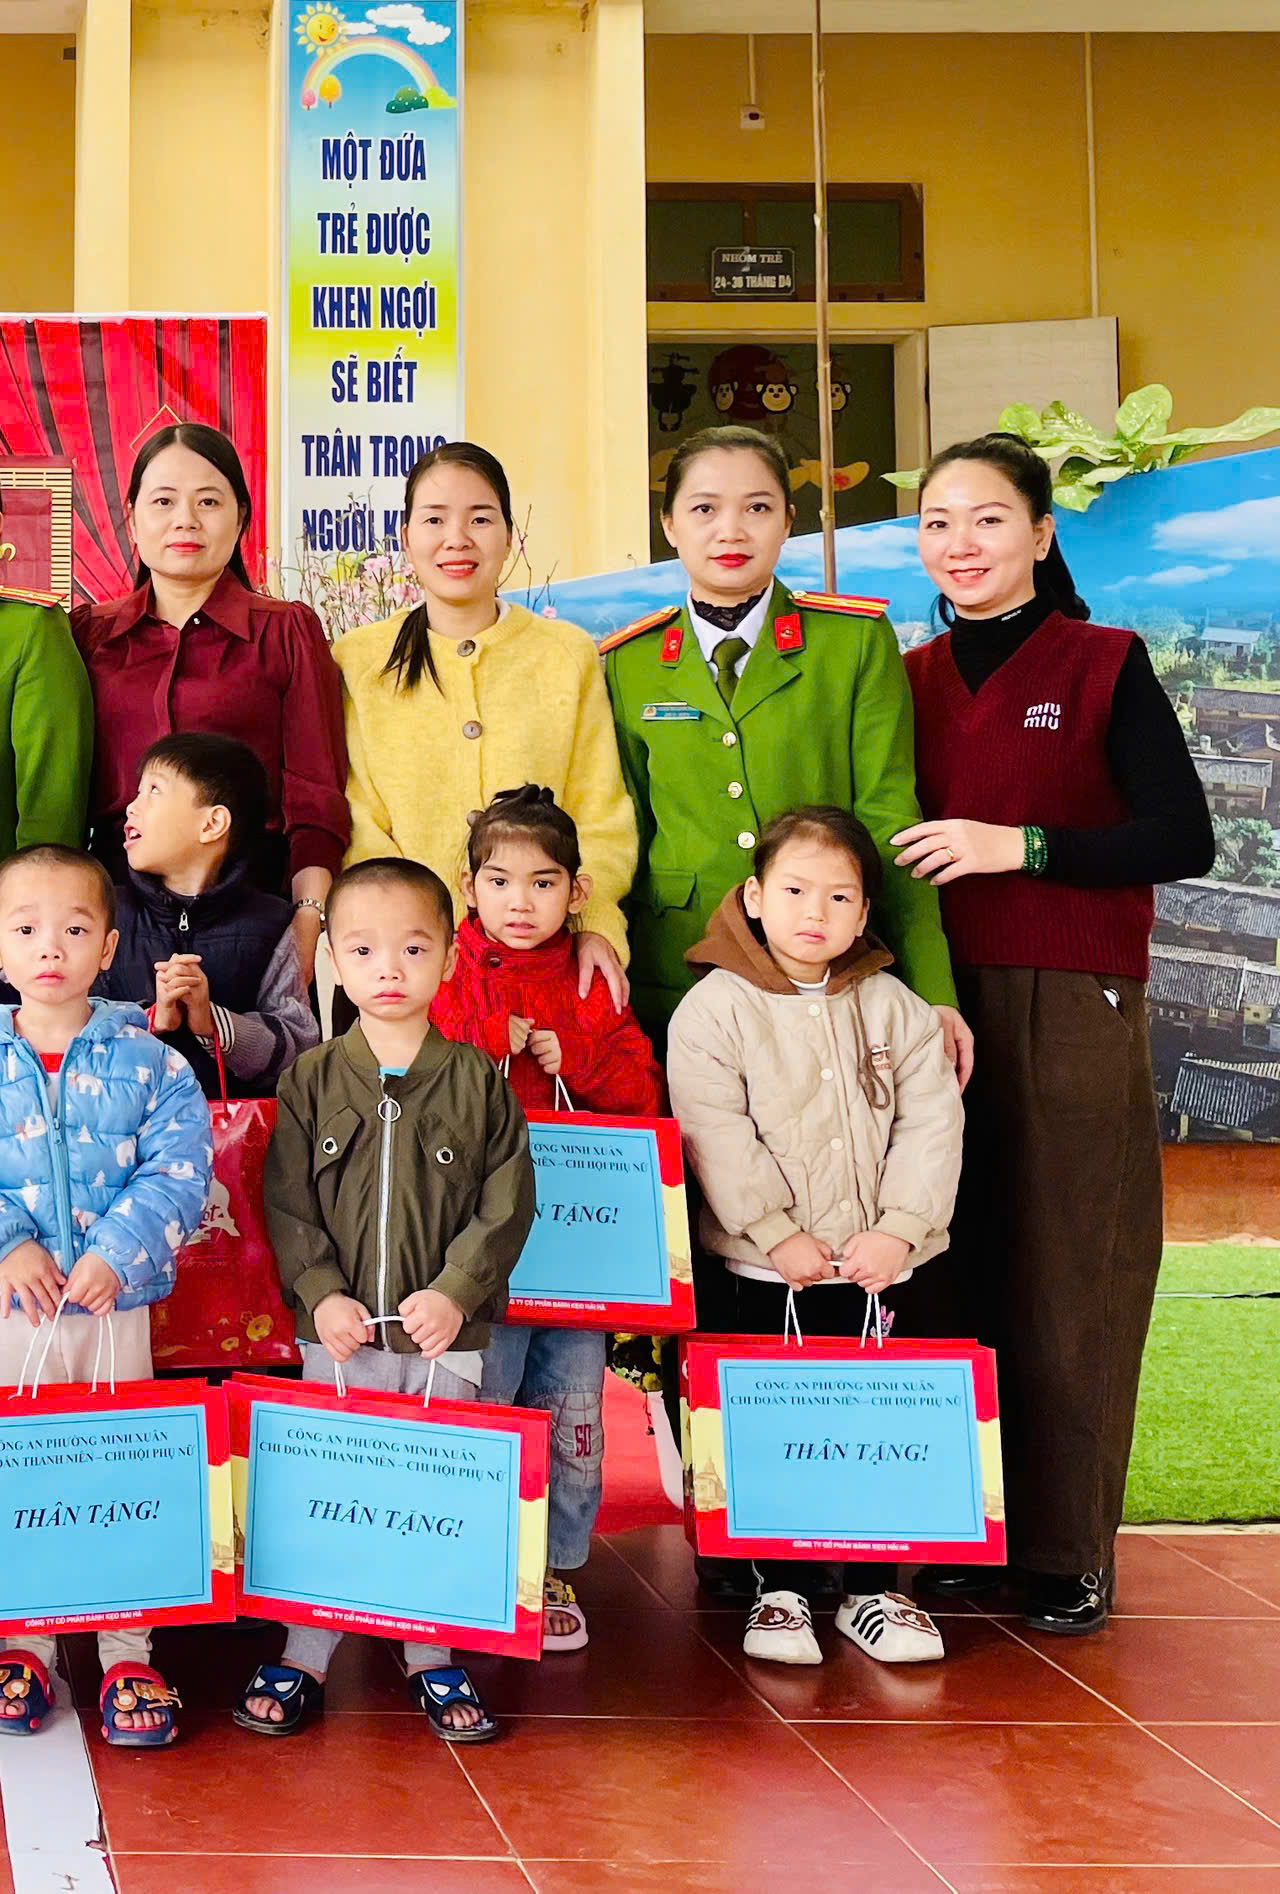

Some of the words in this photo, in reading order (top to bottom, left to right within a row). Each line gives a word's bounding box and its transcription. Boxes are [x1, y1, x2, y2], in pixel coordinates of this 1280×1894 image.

[322, 131, 372, 188] MỘT
[380, 132, 426, 180] ĐỨA
[317, 202, 358, 254] TRẺ
[367, 207, 431, 263] ĐƯỢC
[312, 287, 371, 328] KHEN
[380, 281, 436, 337] NGỢI
[331, 354, 358, 403] SẼ
[367, 347, 417, 403] BIẾT
[302, 428, 361, 477] TRÂN
[303, 503, 374, 551] NGƯỜI
[551, 1203, 618, 1226] TẶNG!
[27, 1439, 43, 1450] AN
[46, 1435, 97, 1449] PHƯỜNG
[100, 1433, 133, 1445] MINH
[135, 1428, 168, 1443] XUÂN
[783, 1438, 849, 1461] THÂN
[856, 1441, 929, 1466] TẶNG!
[14, 1501, 81, 1530] THÂN
[87, 1500, 160, 1528] TẶNG!
[308, 1499, 378, 1526] THÂN
[385, 1509, 464, 1538] TẶNG!
